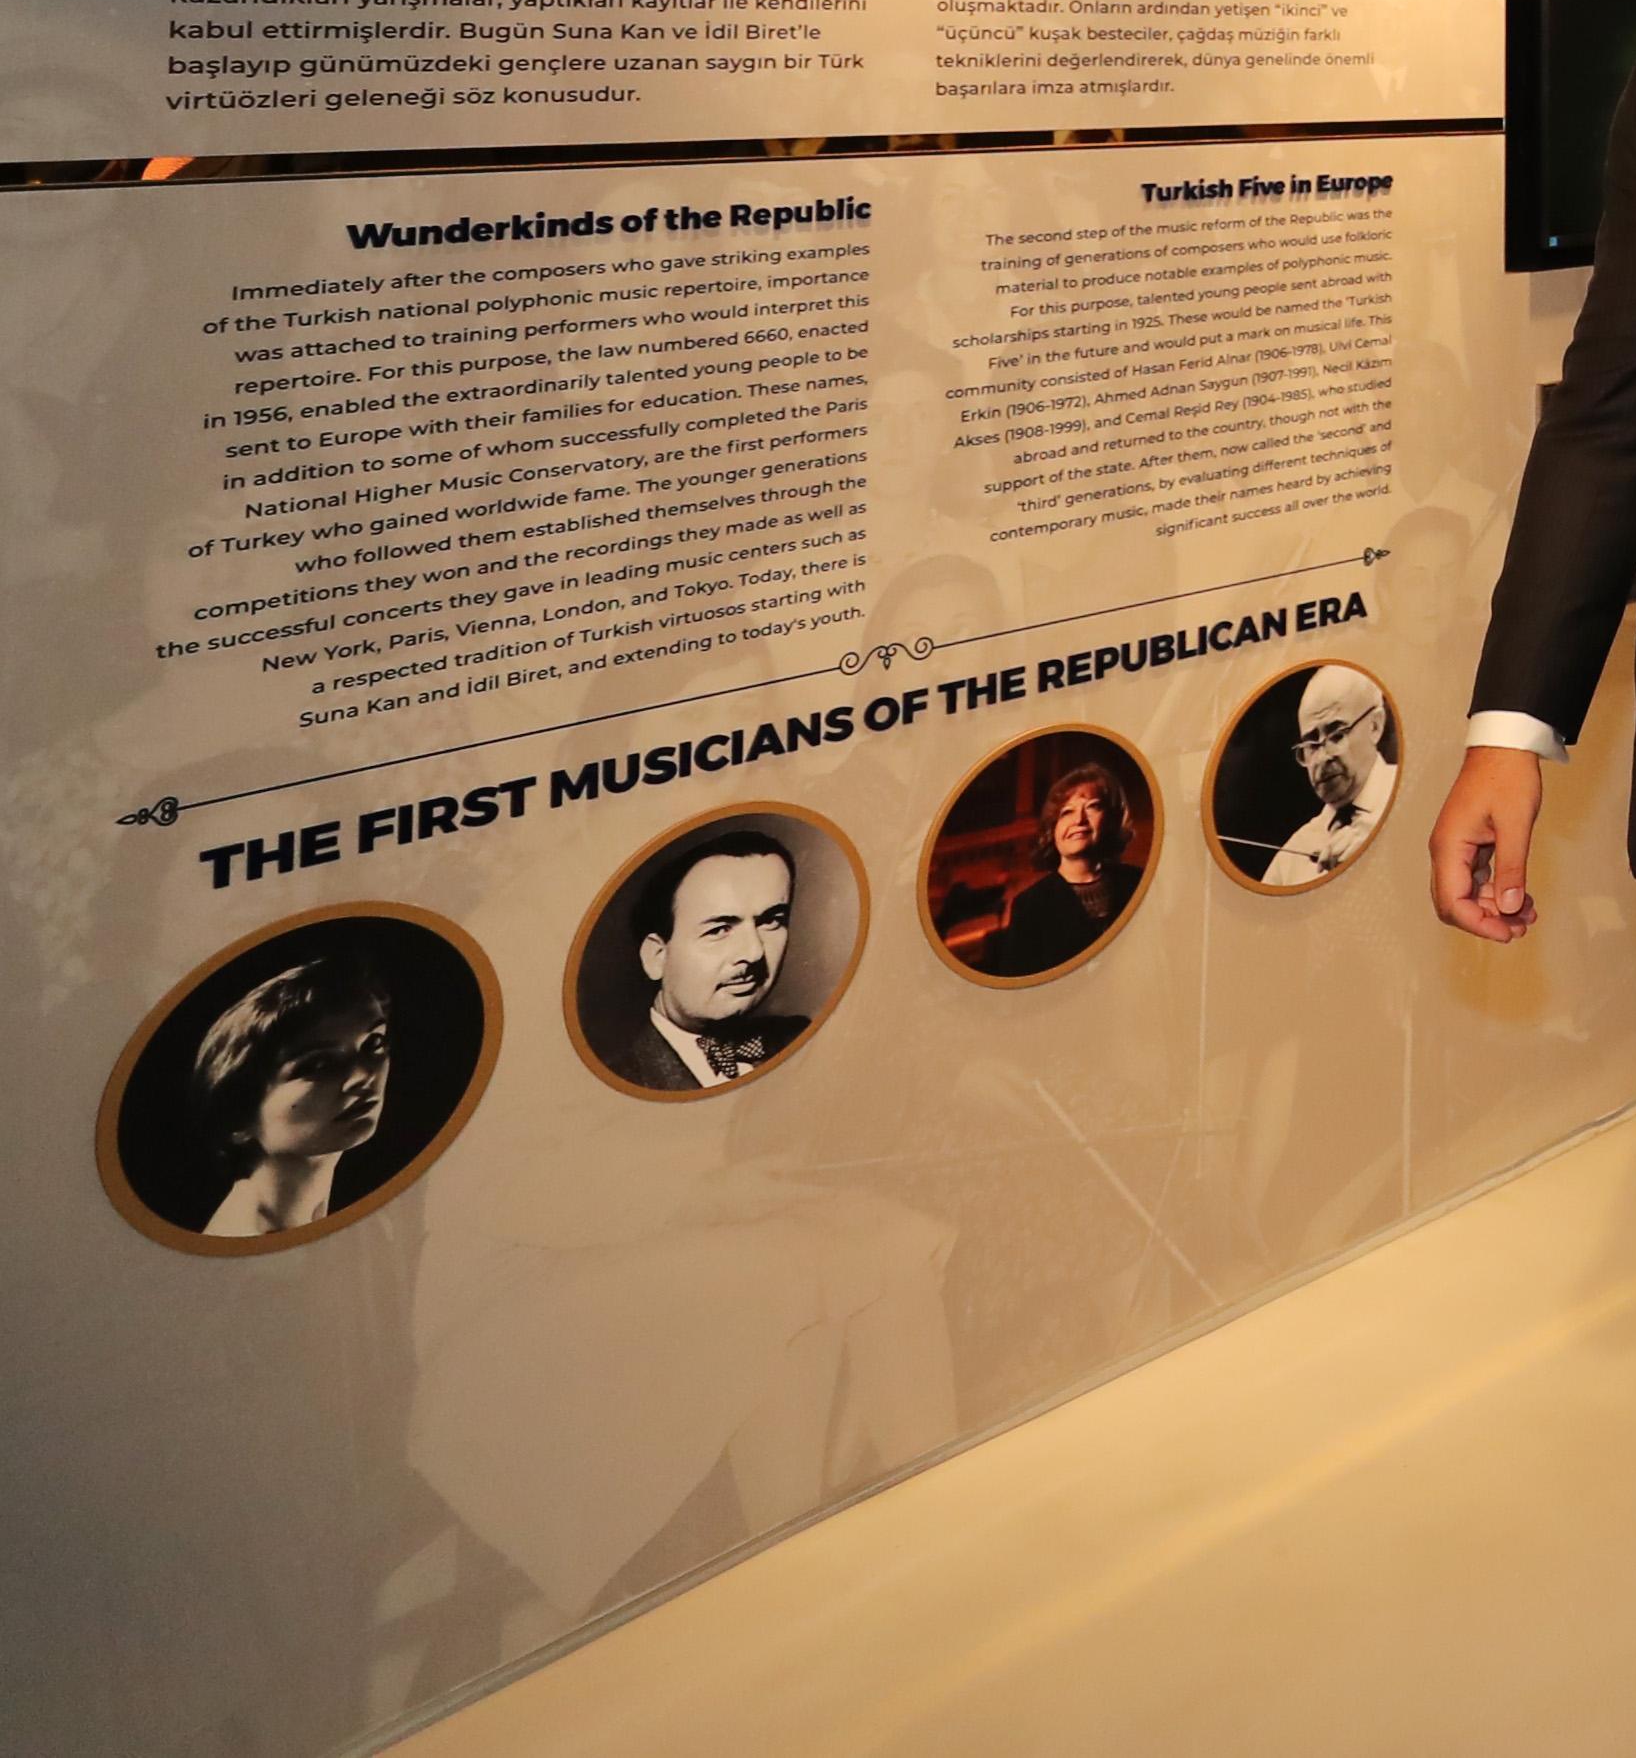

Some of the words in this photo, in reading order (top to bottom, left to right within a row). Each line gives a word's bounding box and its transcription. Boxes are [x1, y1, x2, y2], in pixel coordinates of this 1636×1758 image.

[169, 20, 253, 39] kabul
[261, 20, 451, 45] ettirmişlerdir.
[459, 22, 545, 44] Bugün
[551, 22, 613, 40] Suna
[620, 23, 665, 40] Kan
[671, 27, 698, 40] ve
[705, 20, 739, 40] İdil
[745, 23, 822, 40] Biret'le
[165, 89, 317, 110] virtüözleri
[324, 87, 445, 112] geleneği
[452, 87, 496, 105] söz
[503, 85, 641, 104] konusudur.
[935, 80, 1027, 100] başarılara
[1032, 79, 1075, 95] imza
[1079, 78, 1175, 97] atmışlardır.
[1141, 178, 1234, 203] Turkish
[1238, 175, 1286, 198] Five
[1290, 174, 1312, 195] in
[1316, 172, 1394, 199] Europe
[346, 211, 614, 249] Wunderkinds
[620, 207, 659, 234] of
[663, 206, 723, 231] the
[730, 195, 872, 231] Republic
[232, 275, 385, 301] Immediately
[390, 272, 445, 290] after
[449, 269, 487, 285] the
[491, 263, 607, 283] composers
[611, 258, 655, 273] who
[659, 256, 707, 274] gave
[710, 249, 782, 267] striking
[786, 243, 871, 261] examples
[1155, 513, 1229, 538] significant
[1231, 505, 1282, 523] success
[1284, 499, 1300, 513] all
[1302, 496, 1329, 510] over
[1331, 492, 1354, 504] the
[1355, 483, 1392, 499] world.
[299, 705, 359, 728] Suna
[366, 695, 411, 715] Kan
[417, 682, 460, 705] and
[467, 674, 500, 695] İdil
[506, 665, 562, 687] Biret,
[567, 654, 607, 675] and
[612, 636, 713, 666] extending
[717, 632, 738, 645] to
[741, 618, 807, 641] today's
[810, 606, 865, 631] youth.
[199, 820, 341, 889] THE
[358, 776, 537, 854] FIRST
[550, 706, 854, 809] MUSICIANS
[863, 688, 929, 732] OF
[937, 666, 1026, 715] THE
[1037, 607, 1287, 694] REPUBLICAN
[1296, 591, 1368, 632] ERA
